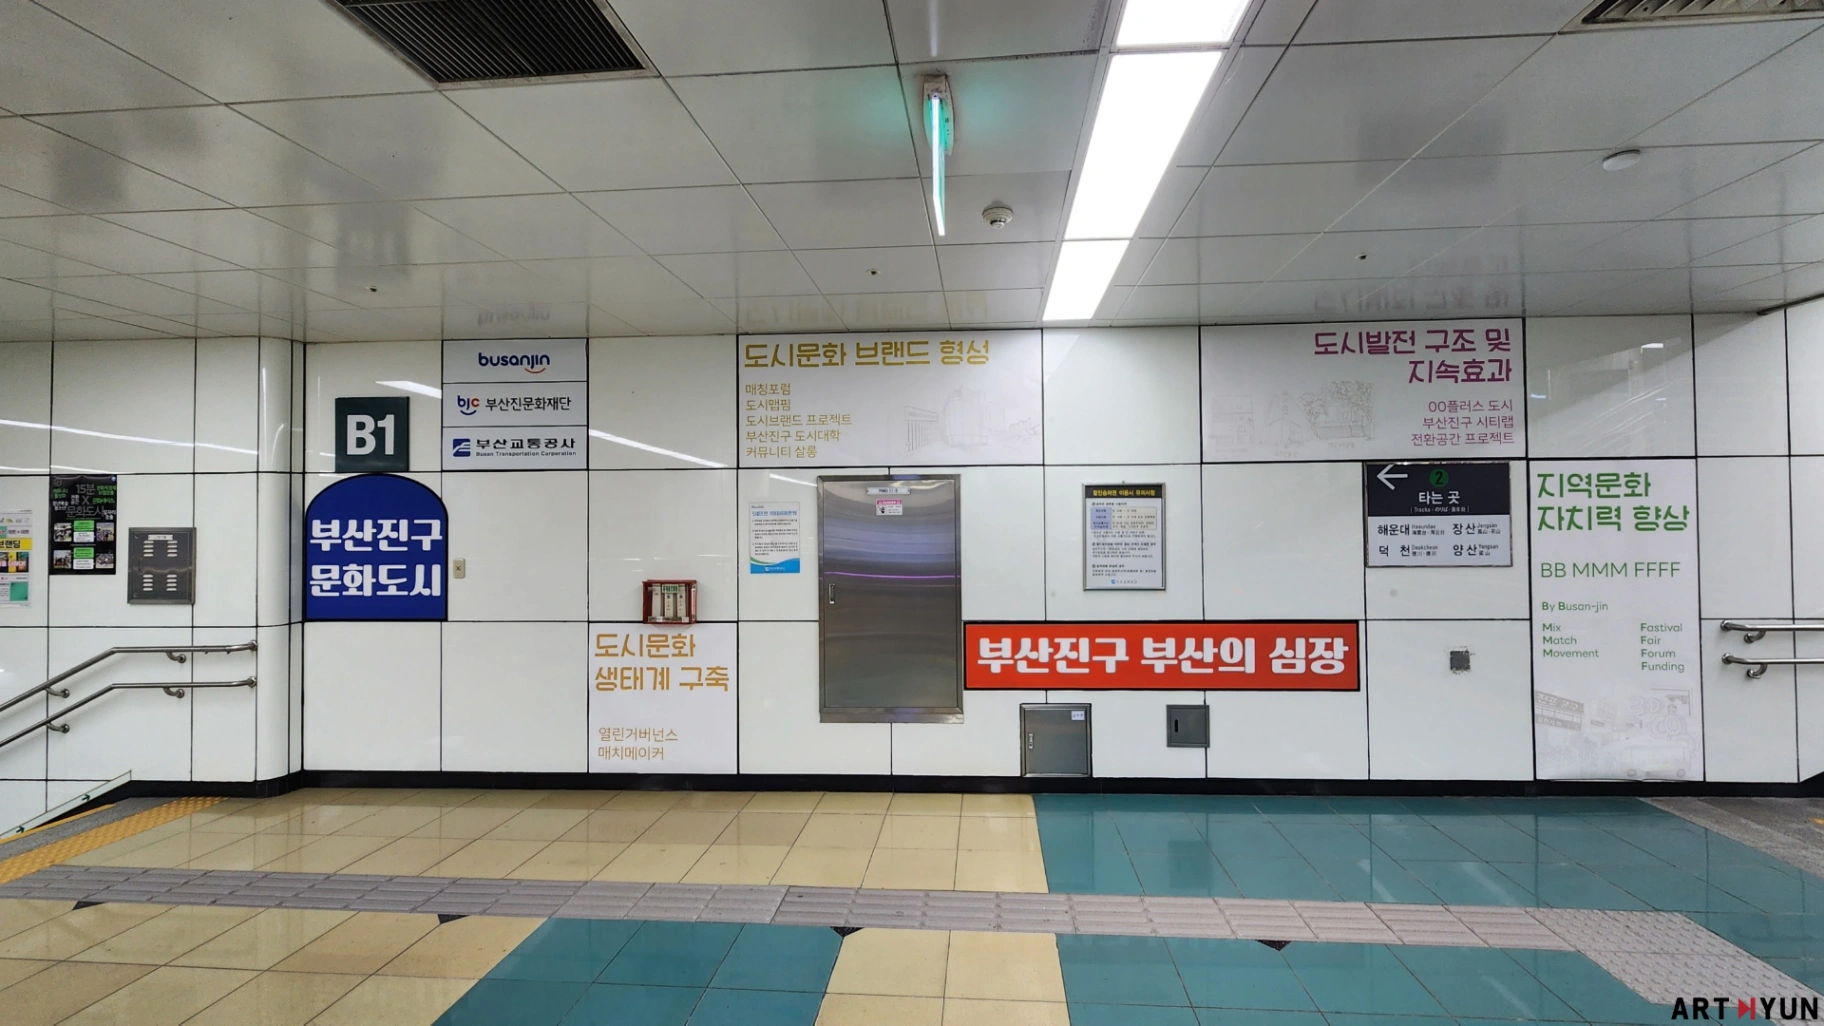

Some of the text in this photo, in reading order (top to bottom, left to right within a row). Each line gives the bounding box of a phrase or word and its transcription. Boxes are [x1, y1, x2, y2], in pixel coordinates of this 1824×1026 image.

[1315, 328, 1510, 354] 도시발전 구조 및
[744, 340, 990, 367] 도시문화 브랜드 형성
[478, 352, 550, 369] busanjin
[1409, 359, 1512, 383] 지속효과
[745, 383, 790, 395] 매칭포럼
[457, 395, 480, 411] bjc
[485, 397, 571, 411] 부산진문화재단
[1488, 399, 1512, 411] 도시
[746, 414, 851, 427] 도시브랜드 프로젝트
[1423, 416, 1513, 429] 부산진구 시티랩
[347, 415, 394, 455] B1
[746, 430, 840, 443] 부산진구 도시대학
[1412, 432, 1514, 446] 전환공간 프로젝트
[476, 438, 576, 450] 부산교통공사
[746, 445, 817, 458] 커뮤니티 살롱
[1435, 471, 1443, 484] 2
[1537, 472, 1651, 498] 지역문화
[1419, 491, 1460, 504] 타는 곳
[1538, 505, 1689, 531] 자치력 향상
[310, 519, 442, 551] 부산진구
[1378, 524, 1410, 536] 해운대
[1541, 562, 1680, 578] BB MMM FFFF
[310, 564, 441, 596] 문화도시
[1542, 602, 1608, 613] By Busan-jin
[1543, 623, 1561, 631] Mix
[1640, 623, 1682, 632] Fastival
[595, 633, 696, 658] 도시문화
[1543, 636, 1577, 644] Match
[1641, 636, 1660, 644] Fair
[978, 637, 1349, 674] 부산진구 부산의 심장
[1543, 649, 1599, 657] Movement
[1641, 649, 1675, 658] Forum
[1641, 662, 1684, 673] Funding
[595, 666, 729, 691] 생태계 구축
[599, 727, 678, 742] 열린거버넌스
[598, 746, 663, 761] 매치메이커
